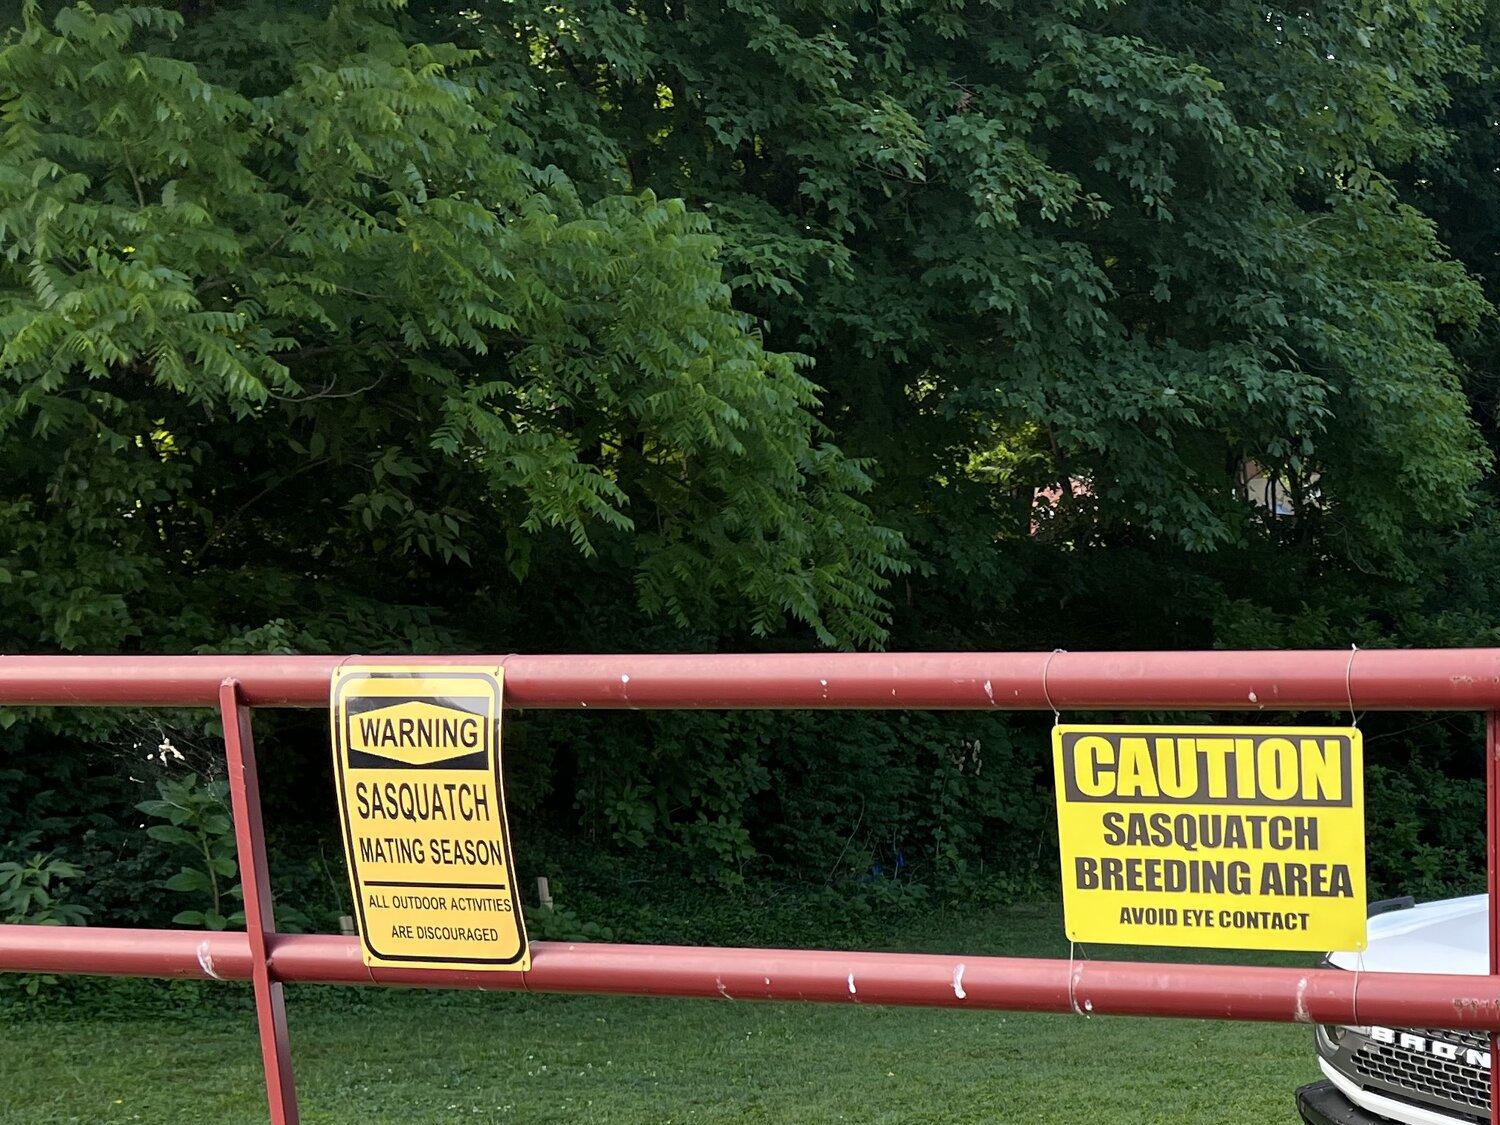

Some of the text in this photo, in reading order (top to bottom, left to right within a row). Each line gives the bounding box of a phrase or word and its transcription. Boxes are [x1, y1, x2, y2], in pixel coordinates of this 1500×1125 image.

[360, 718, 478, 748] WARNING
[1072, 735, 1342, 801] CAUTION
[356, 782, 490, 822] SASQUATCH
[1102, 812, 1319, 851] SASQUATCH
[359, 837, 503, 866] MATING SEASON
[1075, 857, 1354, 898] BREEDING AREA
[369, 894, 512, 912] ALL OUTDOOR ACTIVITIES
[391, 925, 499, 942] ARE DISCOURAGED
[1119, 907, 1310, 930] AVOID EYE CONTACT
